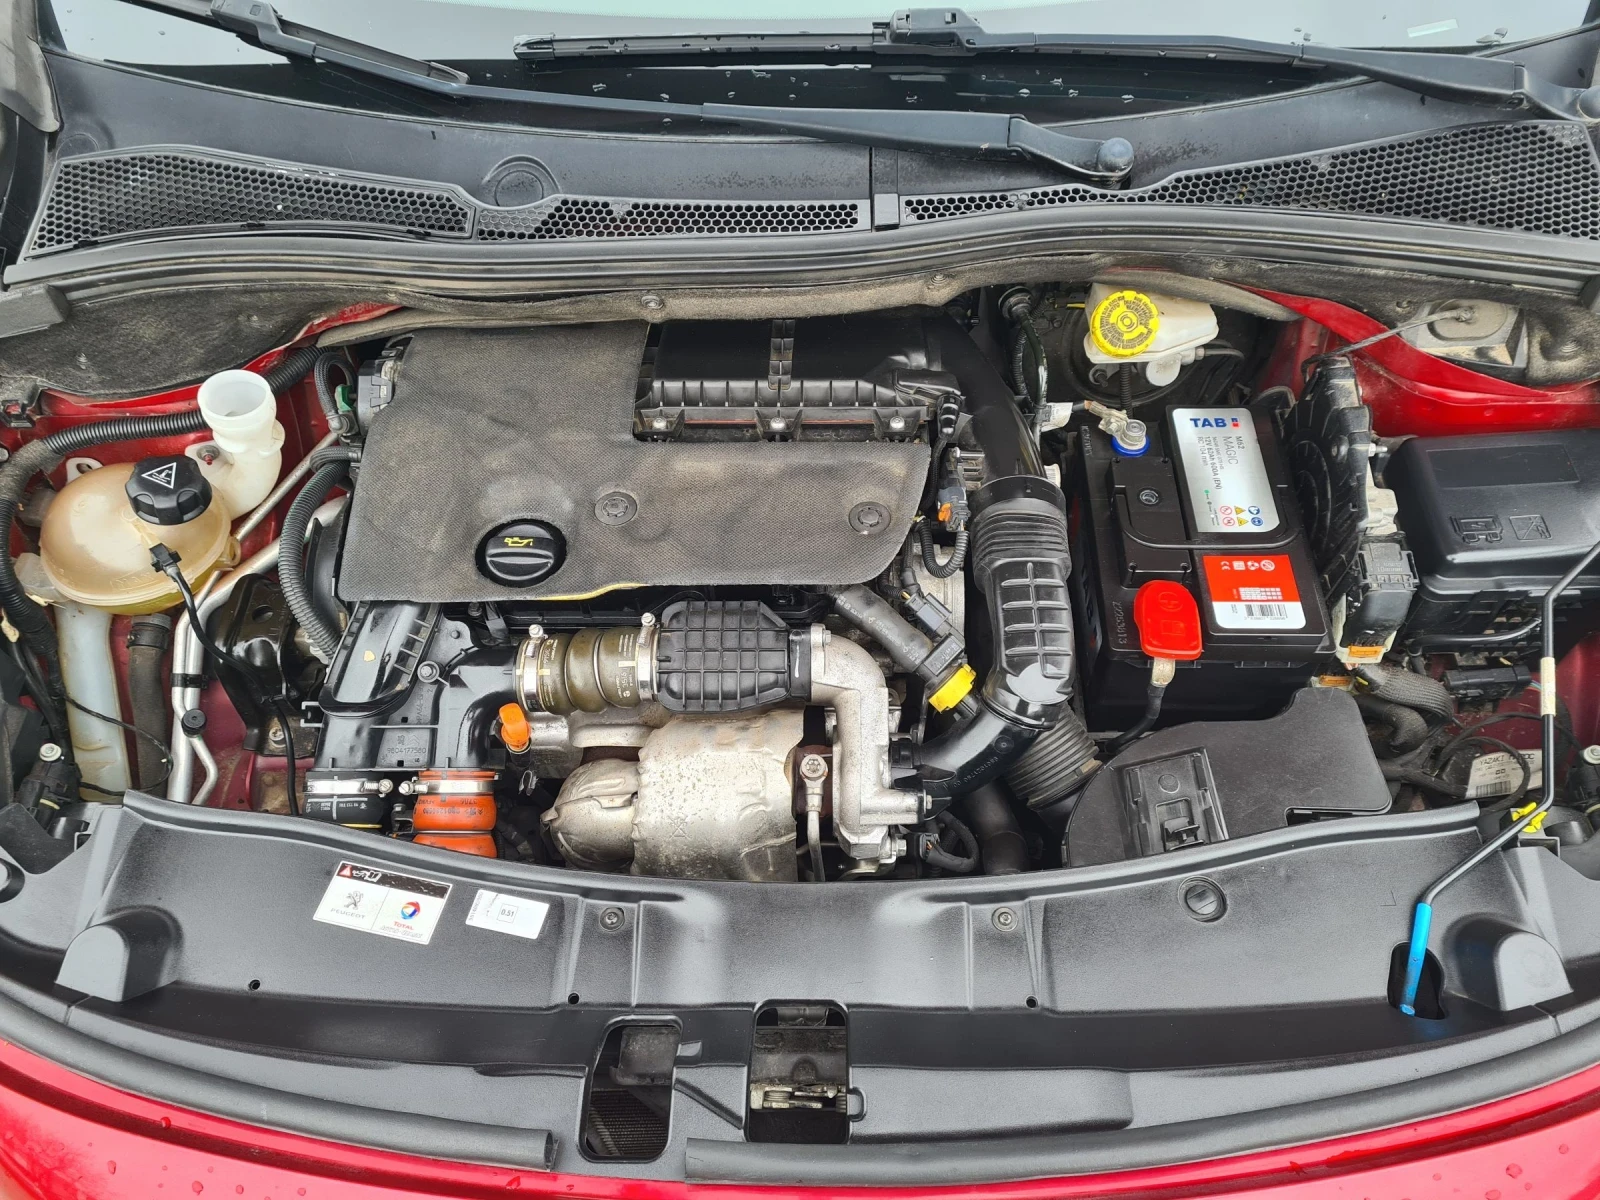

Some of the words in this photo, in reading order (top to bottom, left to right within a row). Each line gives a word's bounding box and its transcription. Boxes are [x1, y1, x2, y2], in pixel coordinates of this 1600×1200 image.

[1189, 417, 1227, 428] TAB
[1197, 436, 1205, 444] RC
[1204, 436, 1212, 446] 12V
[1235, 436, 1245, 450] M62
[1199, 445, 1207, 455] 104
[1207, 447, 1215, 461] 62Ah
[1222, 436, 1239, 465] MAGIC
[1210, 462, 1219, 477] 600A
[1212, 477, 1222, 489] (EN)
[1480, 755, 1504, 765] YAZAKI
[331, 907, 366, 920] PEUGEOT
[501, 908, 514, 918] 0.51
[394, 921, 414, 931] TOTAL
